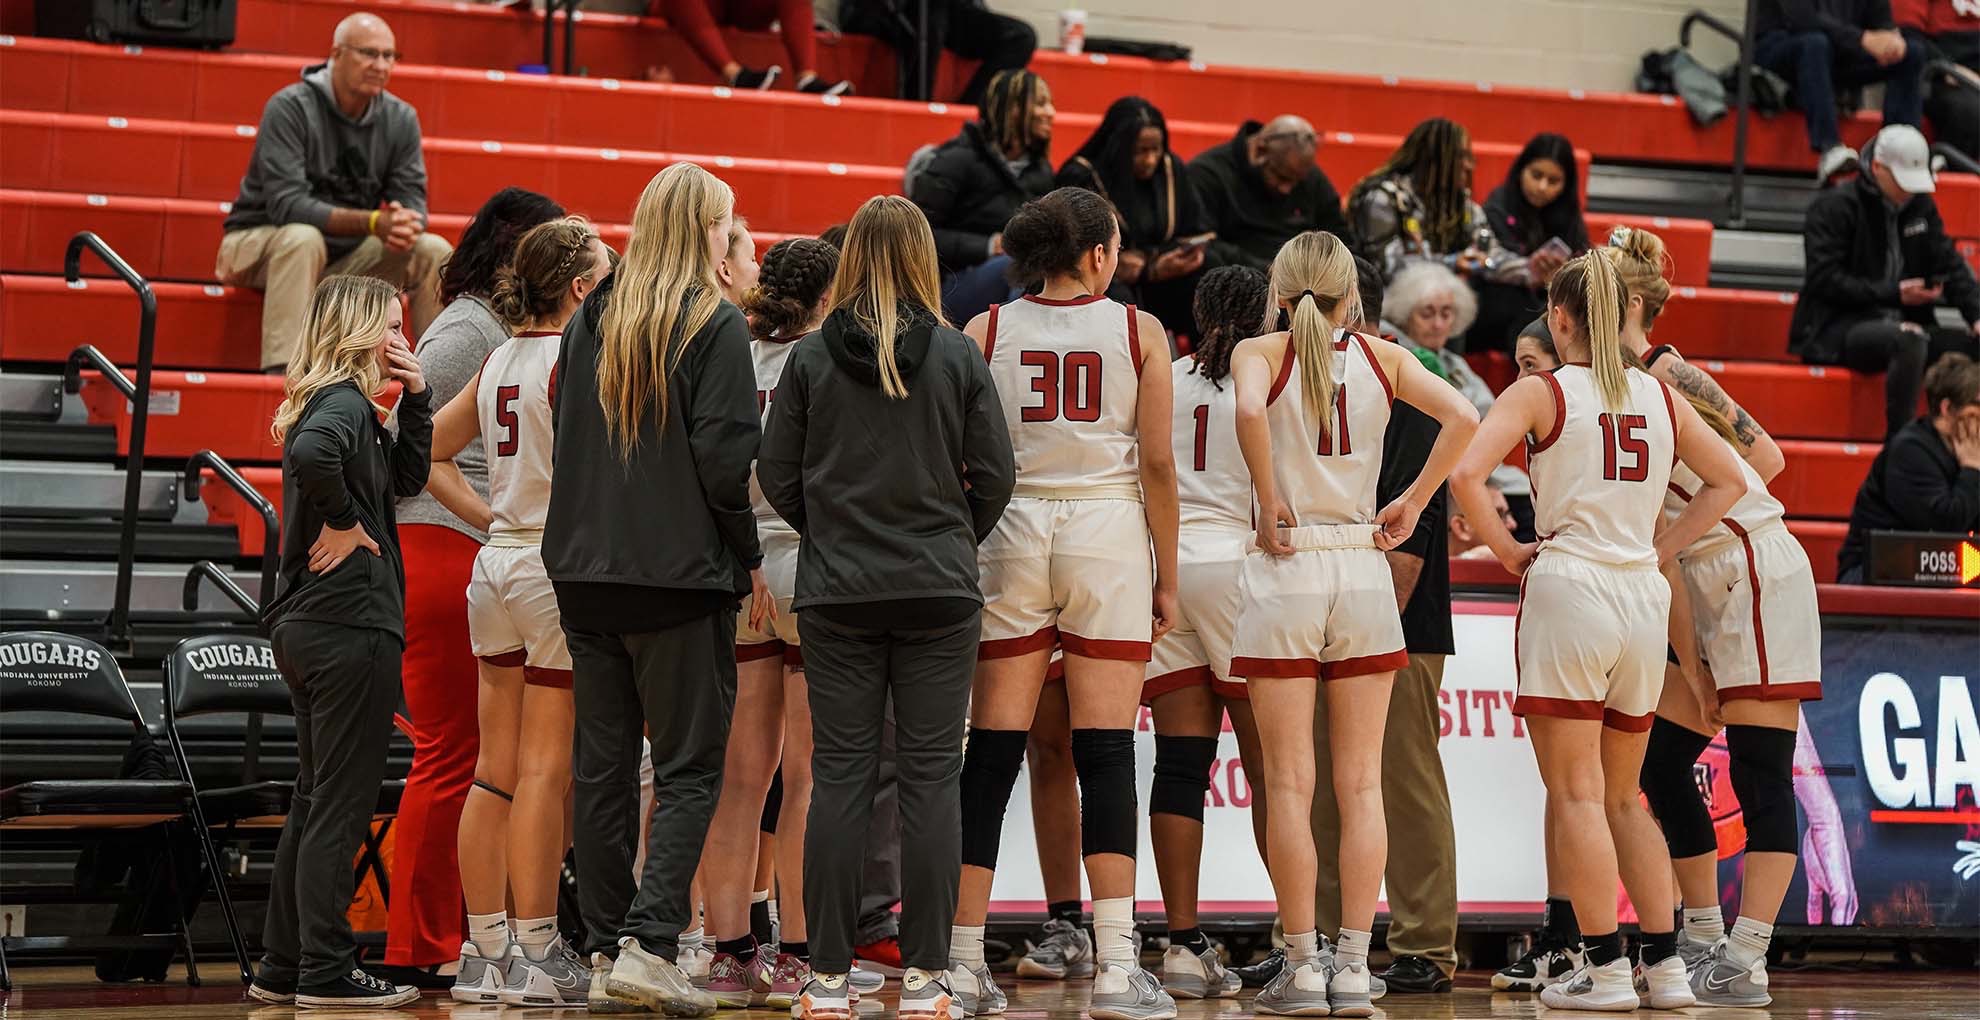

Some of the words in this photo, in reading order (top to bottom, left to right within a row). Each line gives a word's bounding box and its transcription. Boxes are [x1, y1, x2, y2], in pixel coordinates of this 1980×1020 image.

[1021, 351, 1102, 423] 30
[496, 384, 520, 457] 5
[1193, 404, 1209, 471] 1
[1598, 412, 1650, 482] 15
[1920, 551, 1960, 573] POSS.
[0, 642, 101, 671] OUGARS
[0, 671, 36, 679] INDIANA
[236, 673, 283, 681] UNIVERSITY
